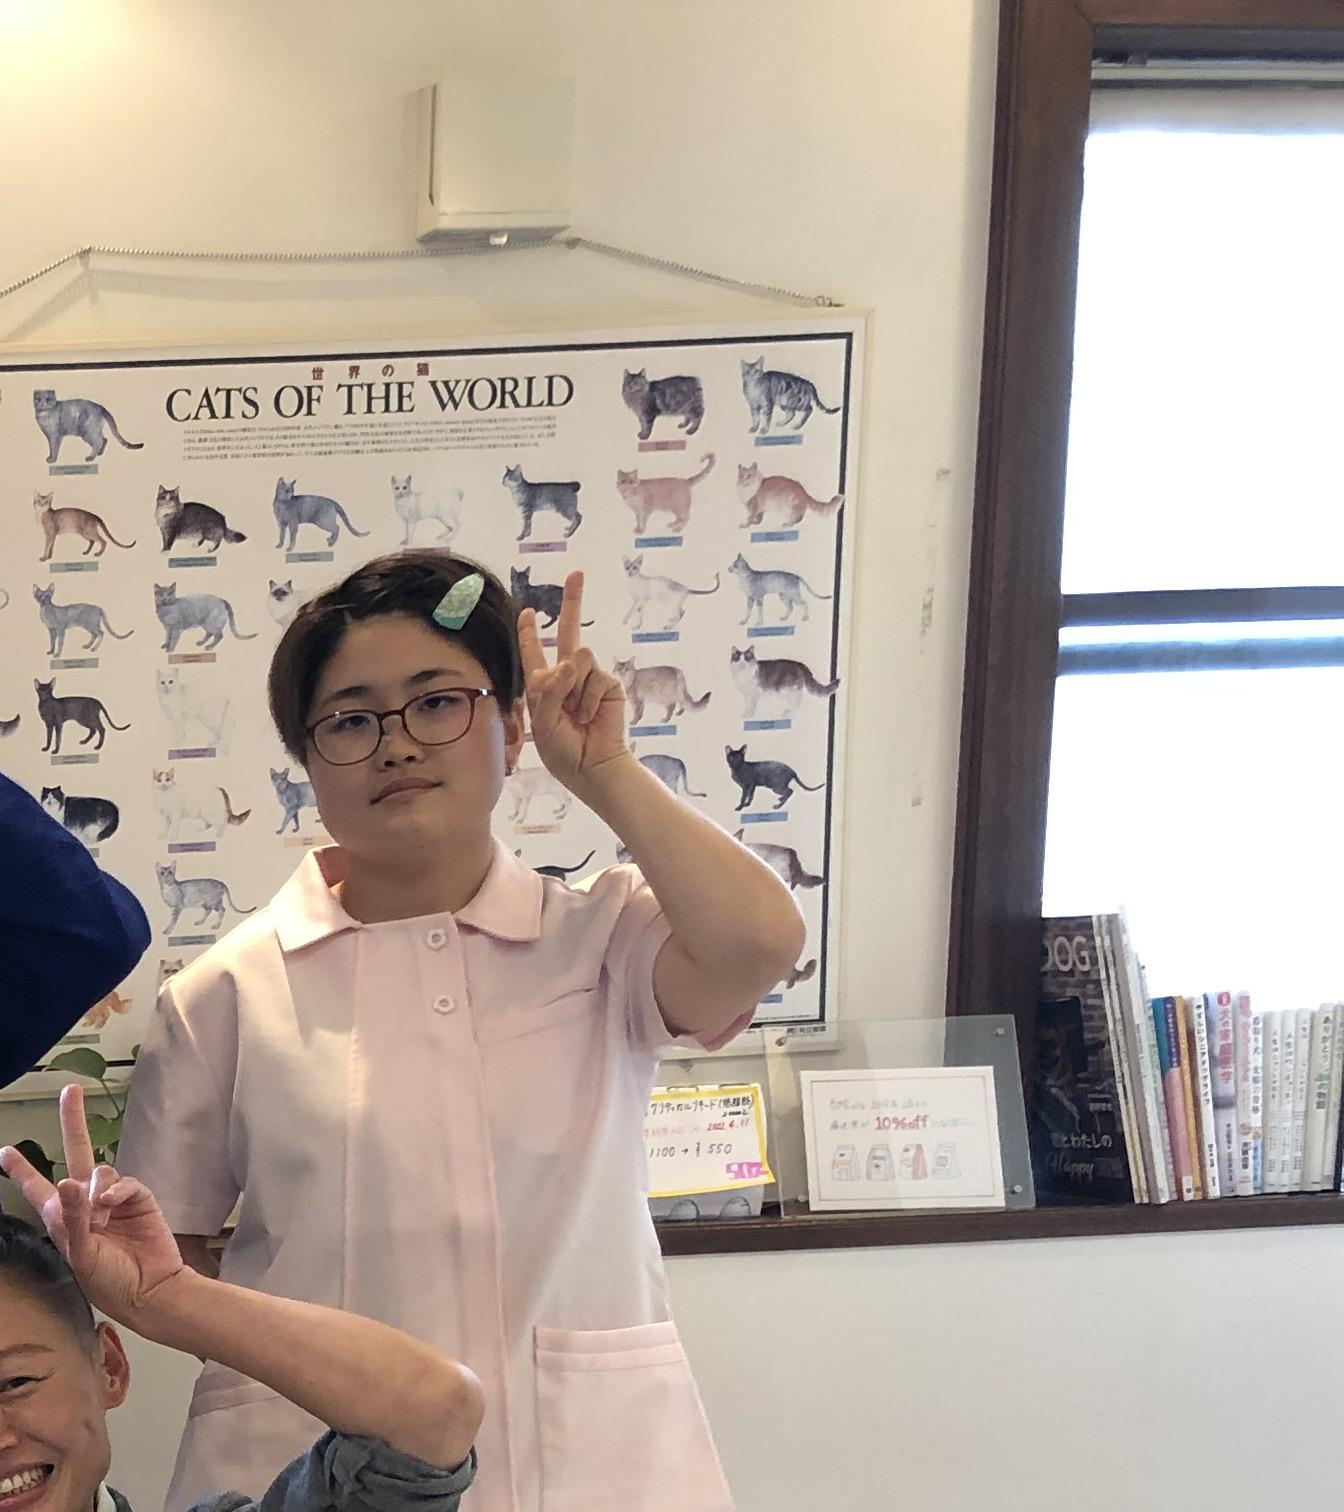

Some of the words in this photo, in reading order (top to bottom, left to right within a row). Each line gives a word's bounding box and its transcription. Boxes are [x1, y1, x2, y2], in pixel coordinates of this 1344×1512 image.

[312, 363, 430, 381] 世界の猫
[165, 384, 260, 423] CATS
[273, 383, 324, 419] OF
[336, 381, 416, 416] THE
[428, 374, 575, 413] WORLD
[875, 1114, 928, 1131] 10%off
